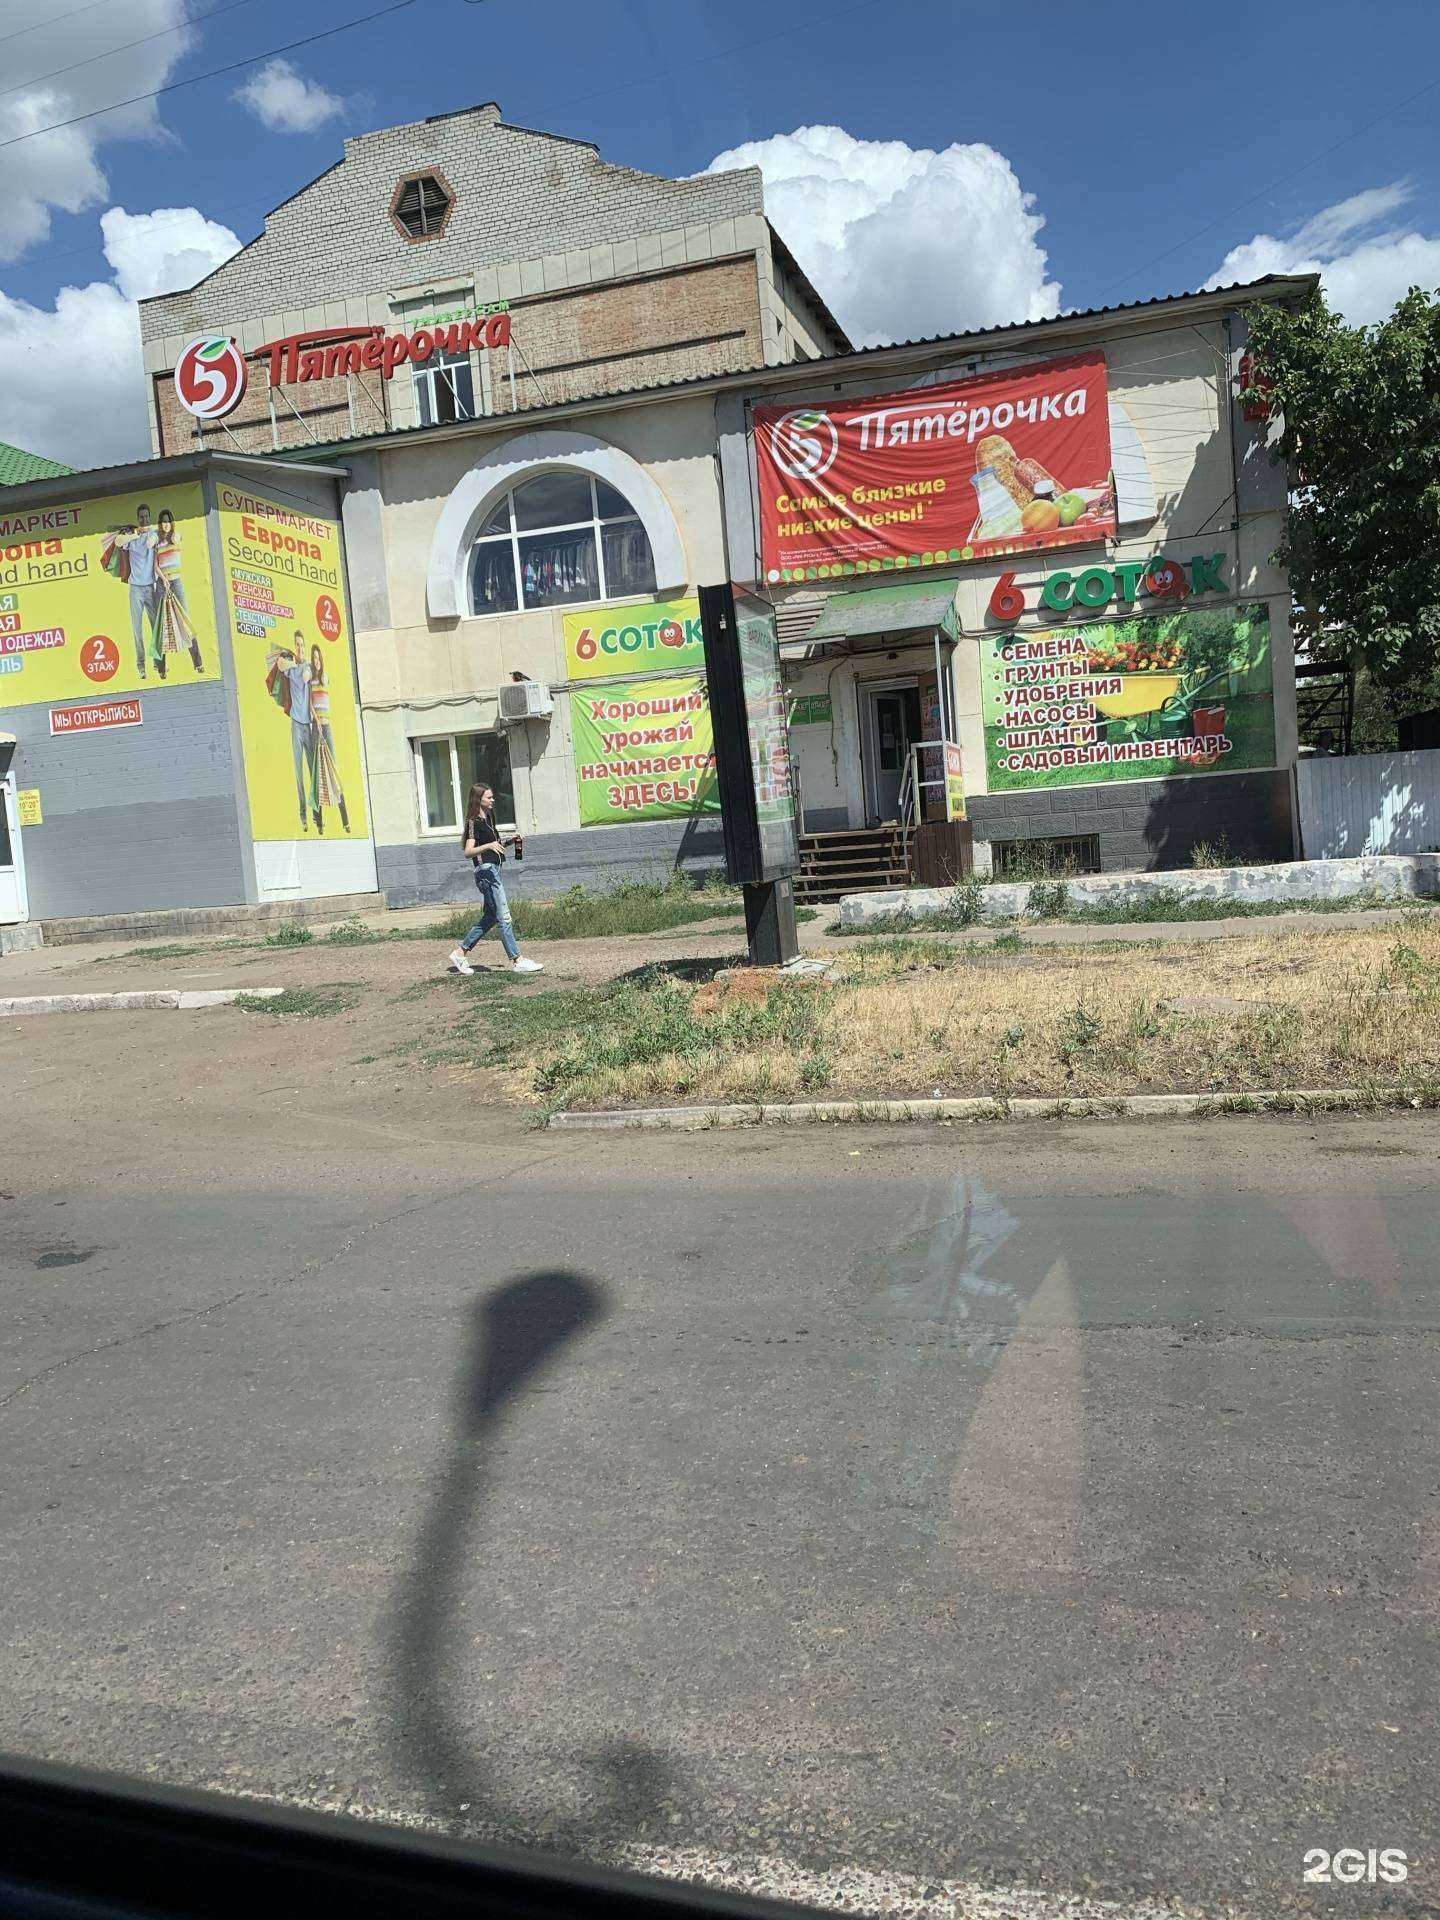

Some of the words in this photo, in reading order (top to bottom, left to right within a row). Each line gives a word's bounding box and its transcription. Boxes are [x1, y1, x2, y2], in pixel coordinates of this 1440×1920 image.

[845, 388, 1088, 451] Пятёрочка
[775, 493, 847, 513] Самые
[851, 478, 947, 505] близкие
[222, 491, 332, 540] СУПЕРМАРКЕТ
[777, 517, 853, 537] низкие
[0, 537, 63, 565] опа
[241, 516, 323, 561] Европа
[28, 553, 88, 580] hand
[227, 537, 294, 573] Second
[299, 558, 338, 585] hand
[234, 568, 272, 586] МУЖСКАЯ
[235, 583, 273, 599] ЖЕНСКАЯ
[989, 571, 1026, 620] 6
[236, 597, 269, 612] ДЕТСКАЯ
[323, 600, 333, 620] 2
[237, 609, 276, 627] ТЕКСТИЛЬ
[239, 624, 266, 637] ОБУВЬ
[320, 620, 339, 633] ЭТАЖ
[6, 630, 64, 653] ОДЕЖДА
[92, 639, 106, 660] 2
[575, 628, 598, 660] 6
[1001, 637, 1087, 662] СЕМЕНА
[87, 661, 115, 674] ЭТАЖ
[1005, 658, 1089, 684] ГРУНТЫ
[1003, 678, 1122, 707] УДОБРЕНИЯ
[54, 713, 72, 728] МЫ
[73, 705, 139, 726] ОТКРЫЛИСЬ!
[591, 690, 703, 723] Хороший
[1005, 703, 1096, 727] НАСОСЫ
[601, 719, 694, 755] урожай
[1007, 726, 1096, 749] ШЛАНГИ
[1007, 743, 1111, 772] САДОВЫЙ
[1112, 735, 1233, 762] ИНВЕНТАРЬ
[607, 779, 698, 809] ЗДЕСЬ!
